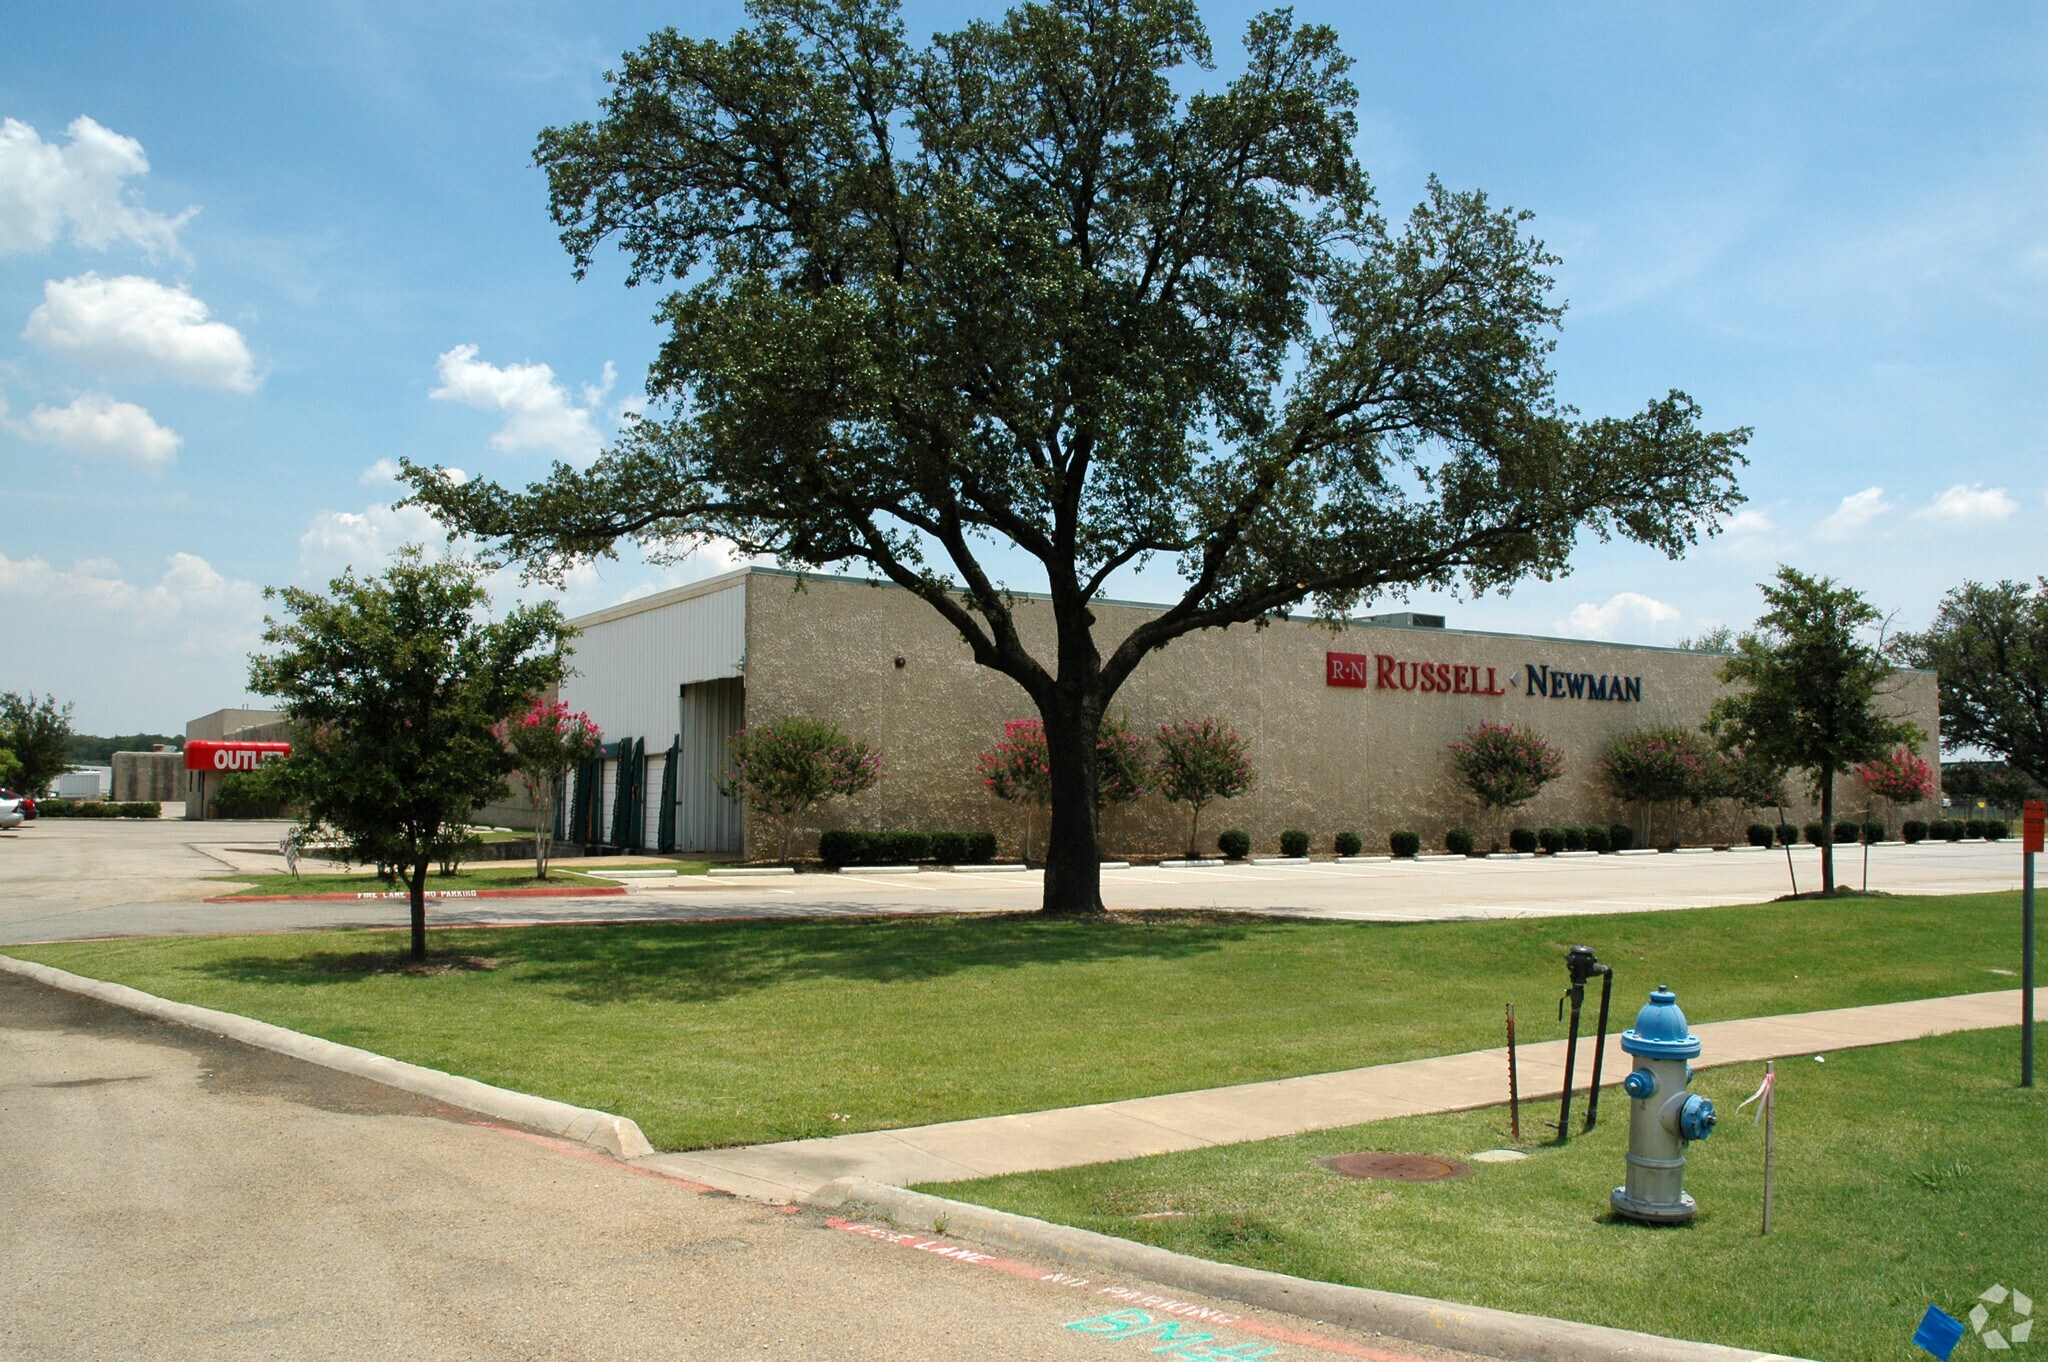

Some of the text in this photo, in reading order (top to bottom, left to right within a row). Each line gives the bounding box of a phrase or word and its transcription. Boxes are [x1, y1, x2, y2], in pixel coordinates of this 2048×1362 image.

[1375, 654, 1641, 702] RUSSELL NEWMAN
[214, 749, 284, 770] OUTL
[441, 889, 476, 897] PARKING
[914, 1241, 996, 1263] LANE
[1097, 1286, 1240, 1324] PARKING
